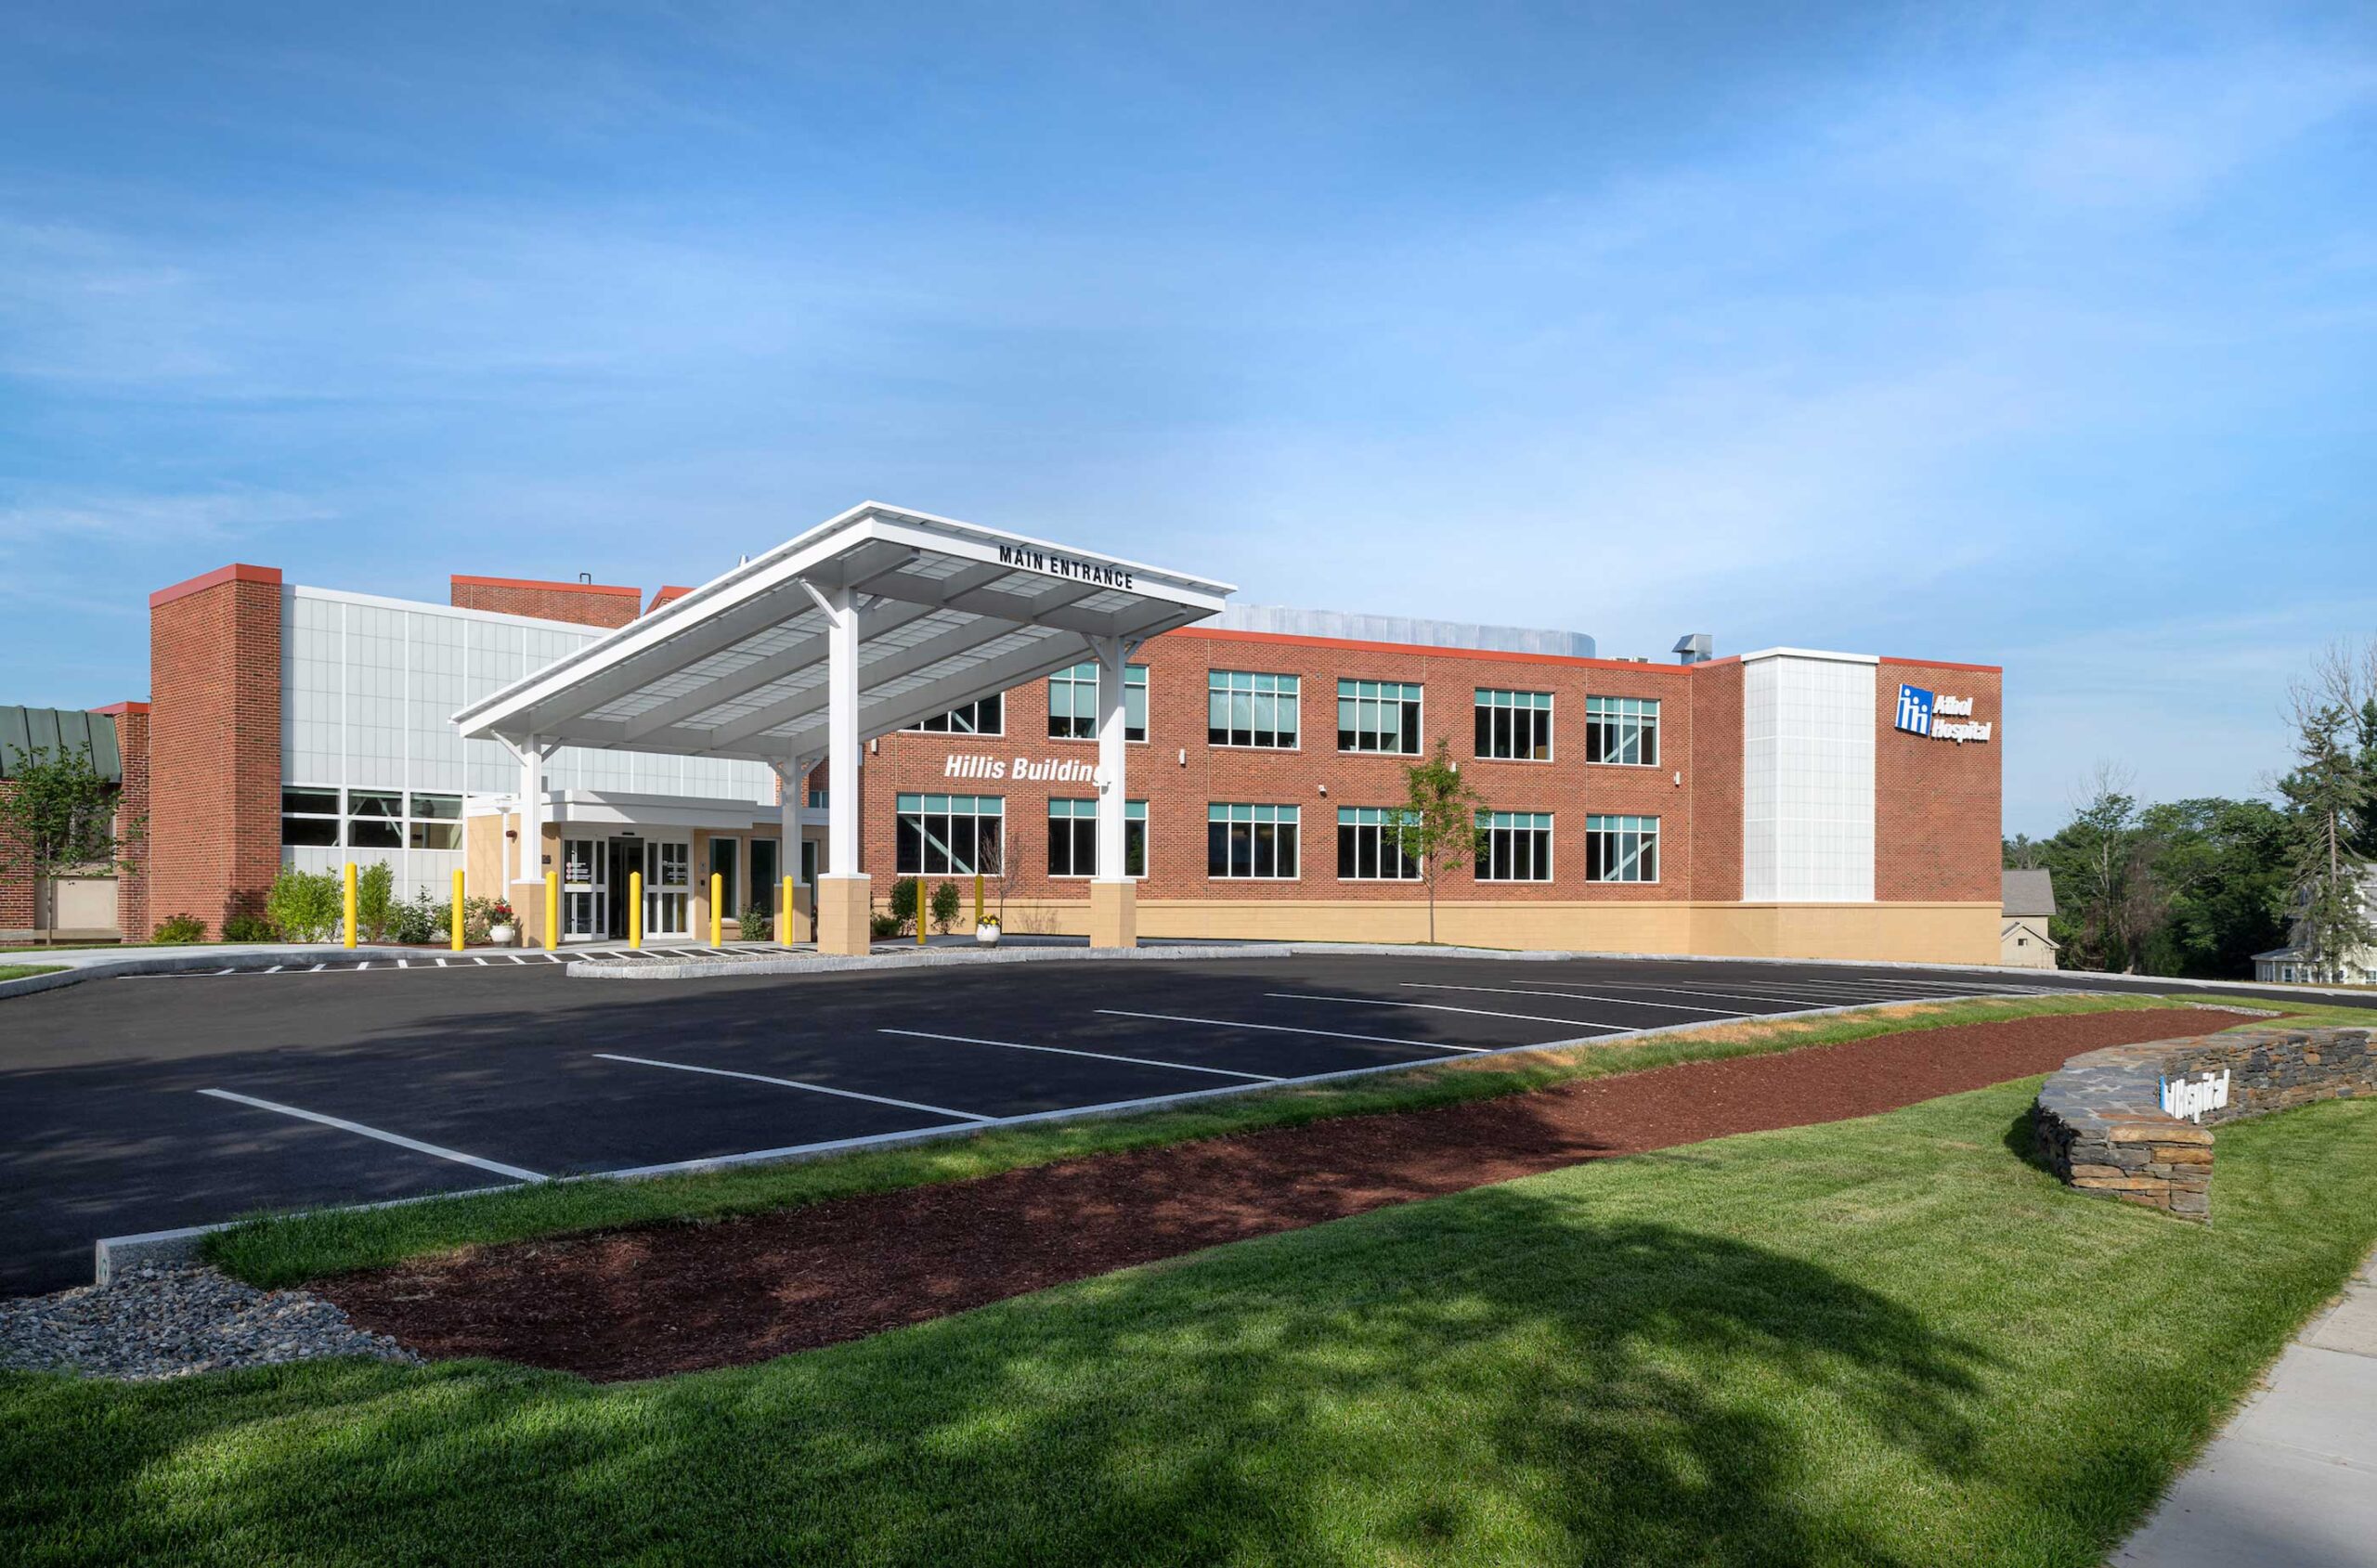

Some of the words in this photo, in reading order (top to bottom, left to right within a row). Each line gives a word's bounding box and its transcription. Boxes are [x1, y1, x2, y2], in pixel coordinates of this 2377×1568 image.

[999, 545, 1044, 571] MAIN
[1050, 556, 1133, 590] ENTRANCE
[1931, 719, 1992, 743] Hospital
[944, 755, 1006, 779] Hillis
